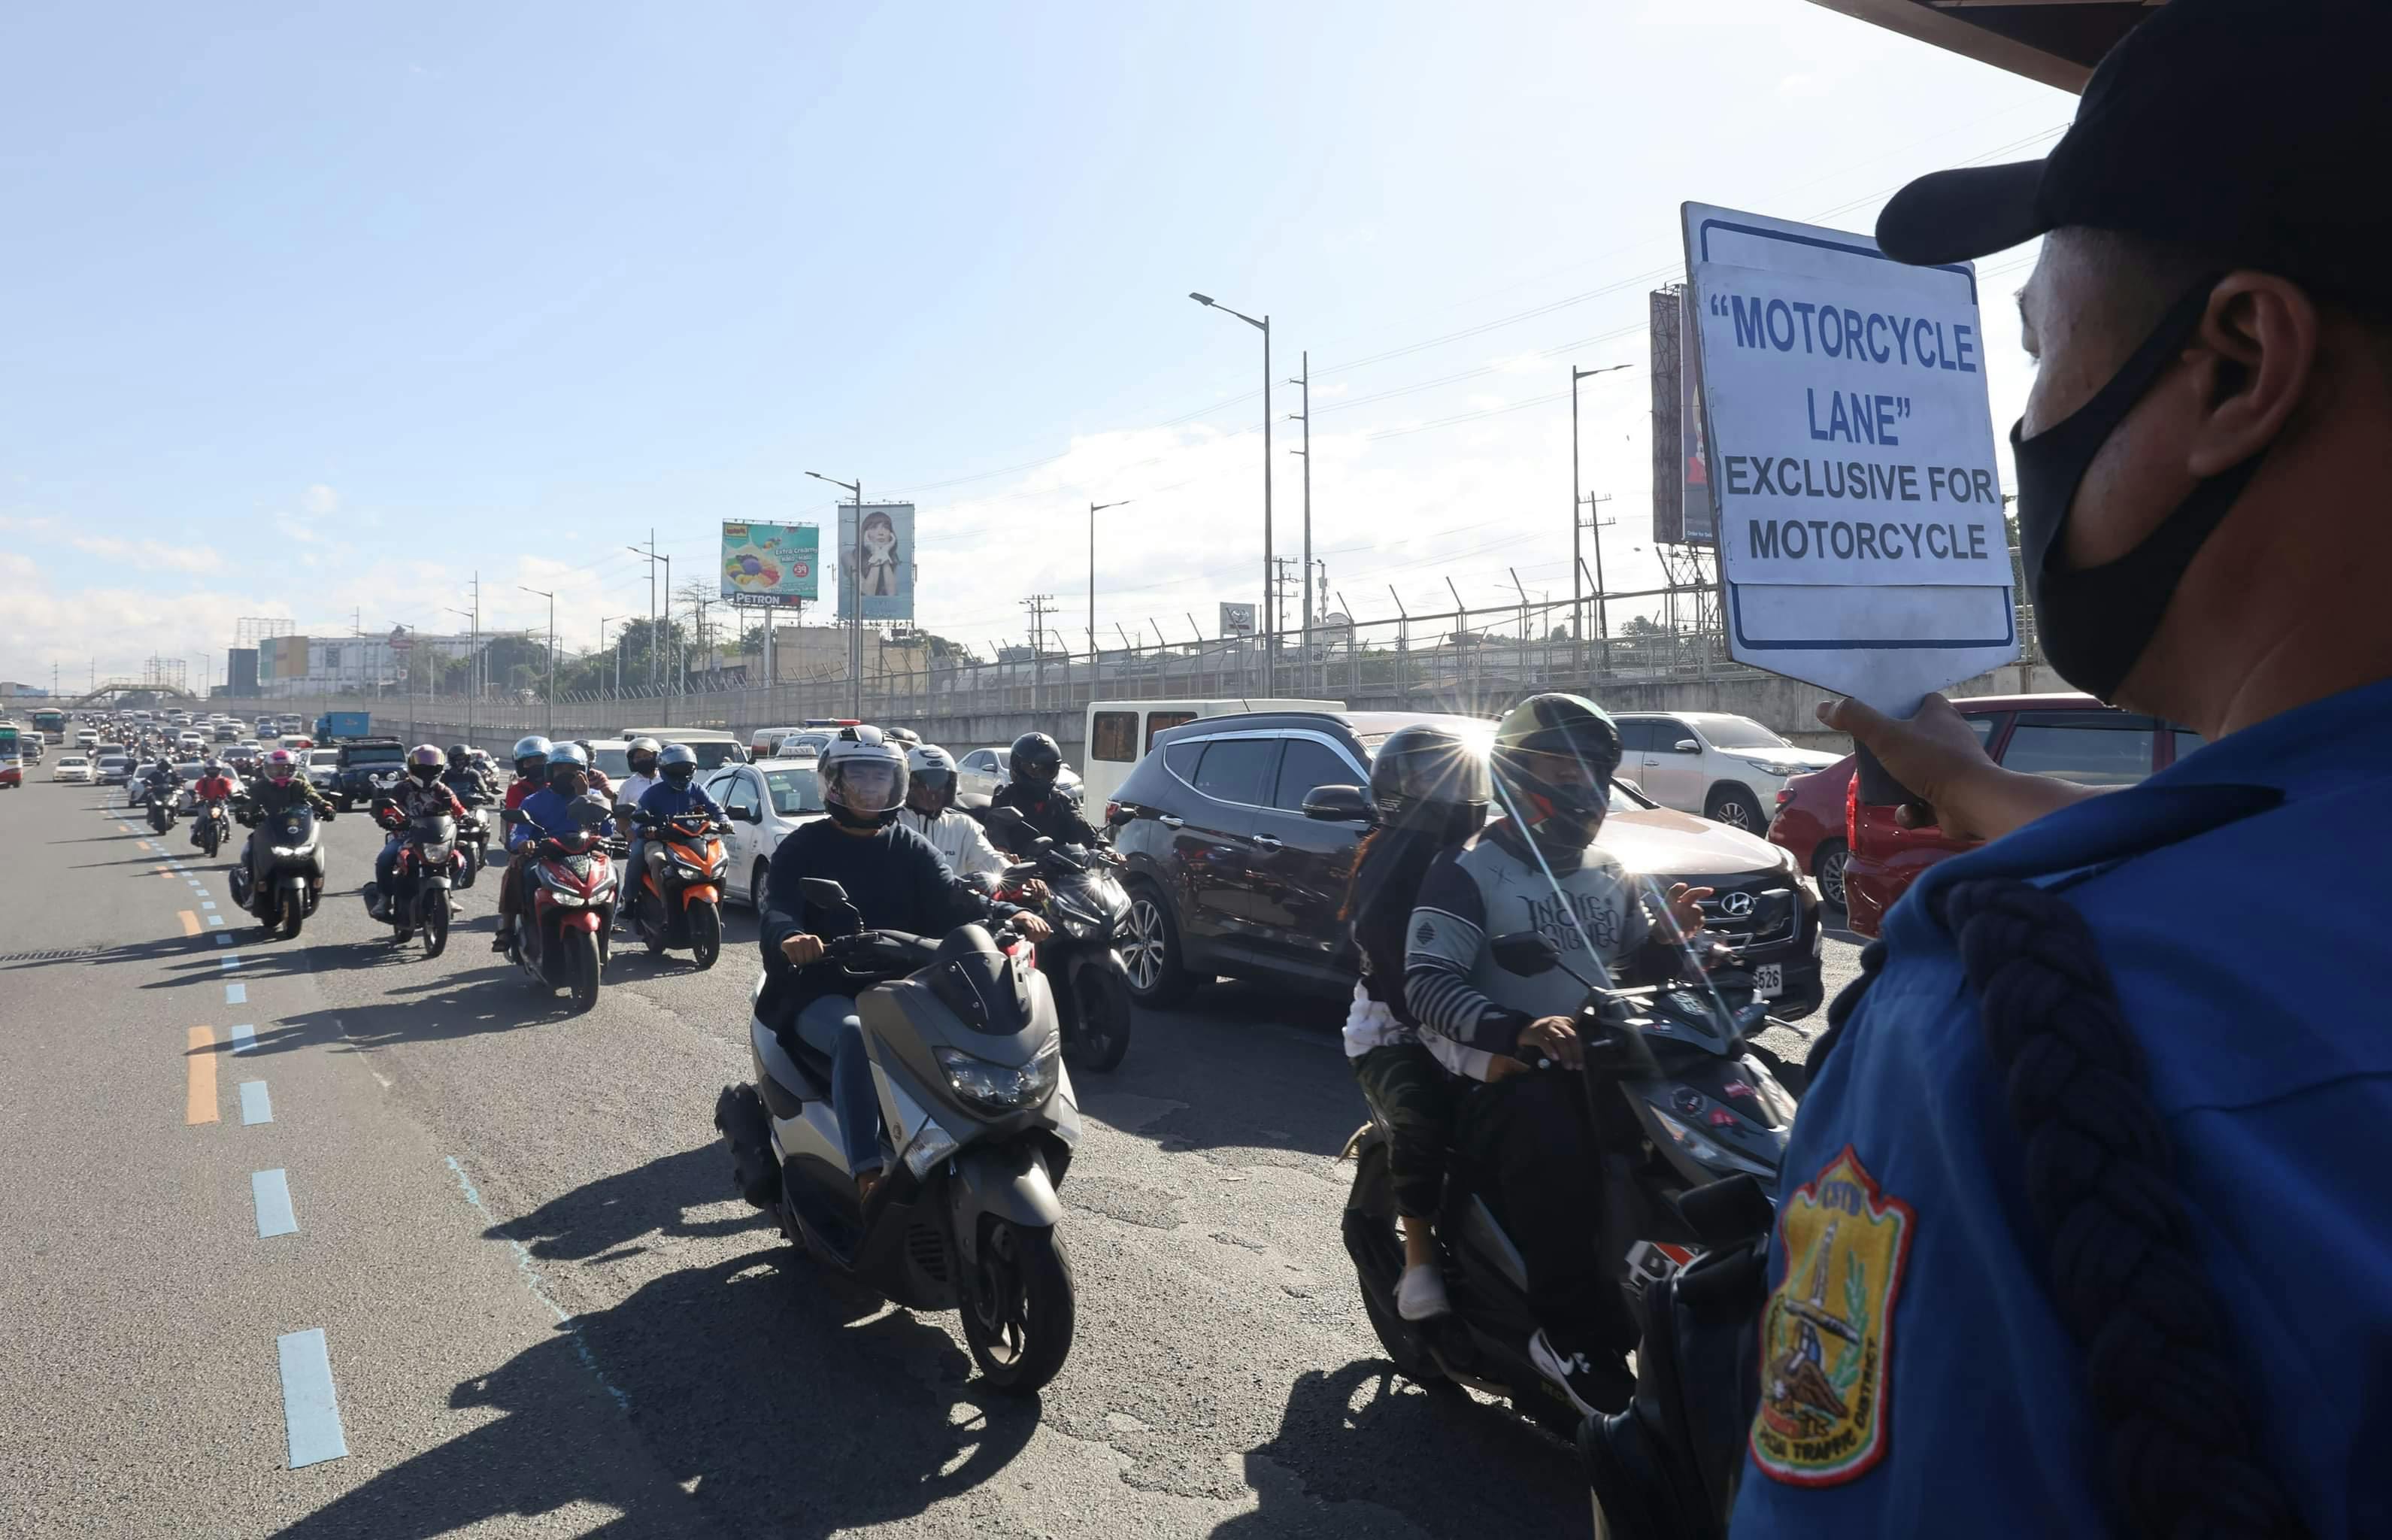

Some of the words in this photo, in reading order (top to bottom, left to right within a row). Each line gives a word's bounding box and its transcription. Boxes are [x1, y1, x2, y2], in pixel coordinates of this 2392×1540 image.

[1711, 293, 1976, 372] “MOTORCYCLE
[1806, 387, 1911, 446] LANE”
[1724, 456, 1921, 502] EXCLUSIVE
[1928, 466, 1995, 504] FOR
[1749, 519, 1988, 560] MOTORCYCLE
